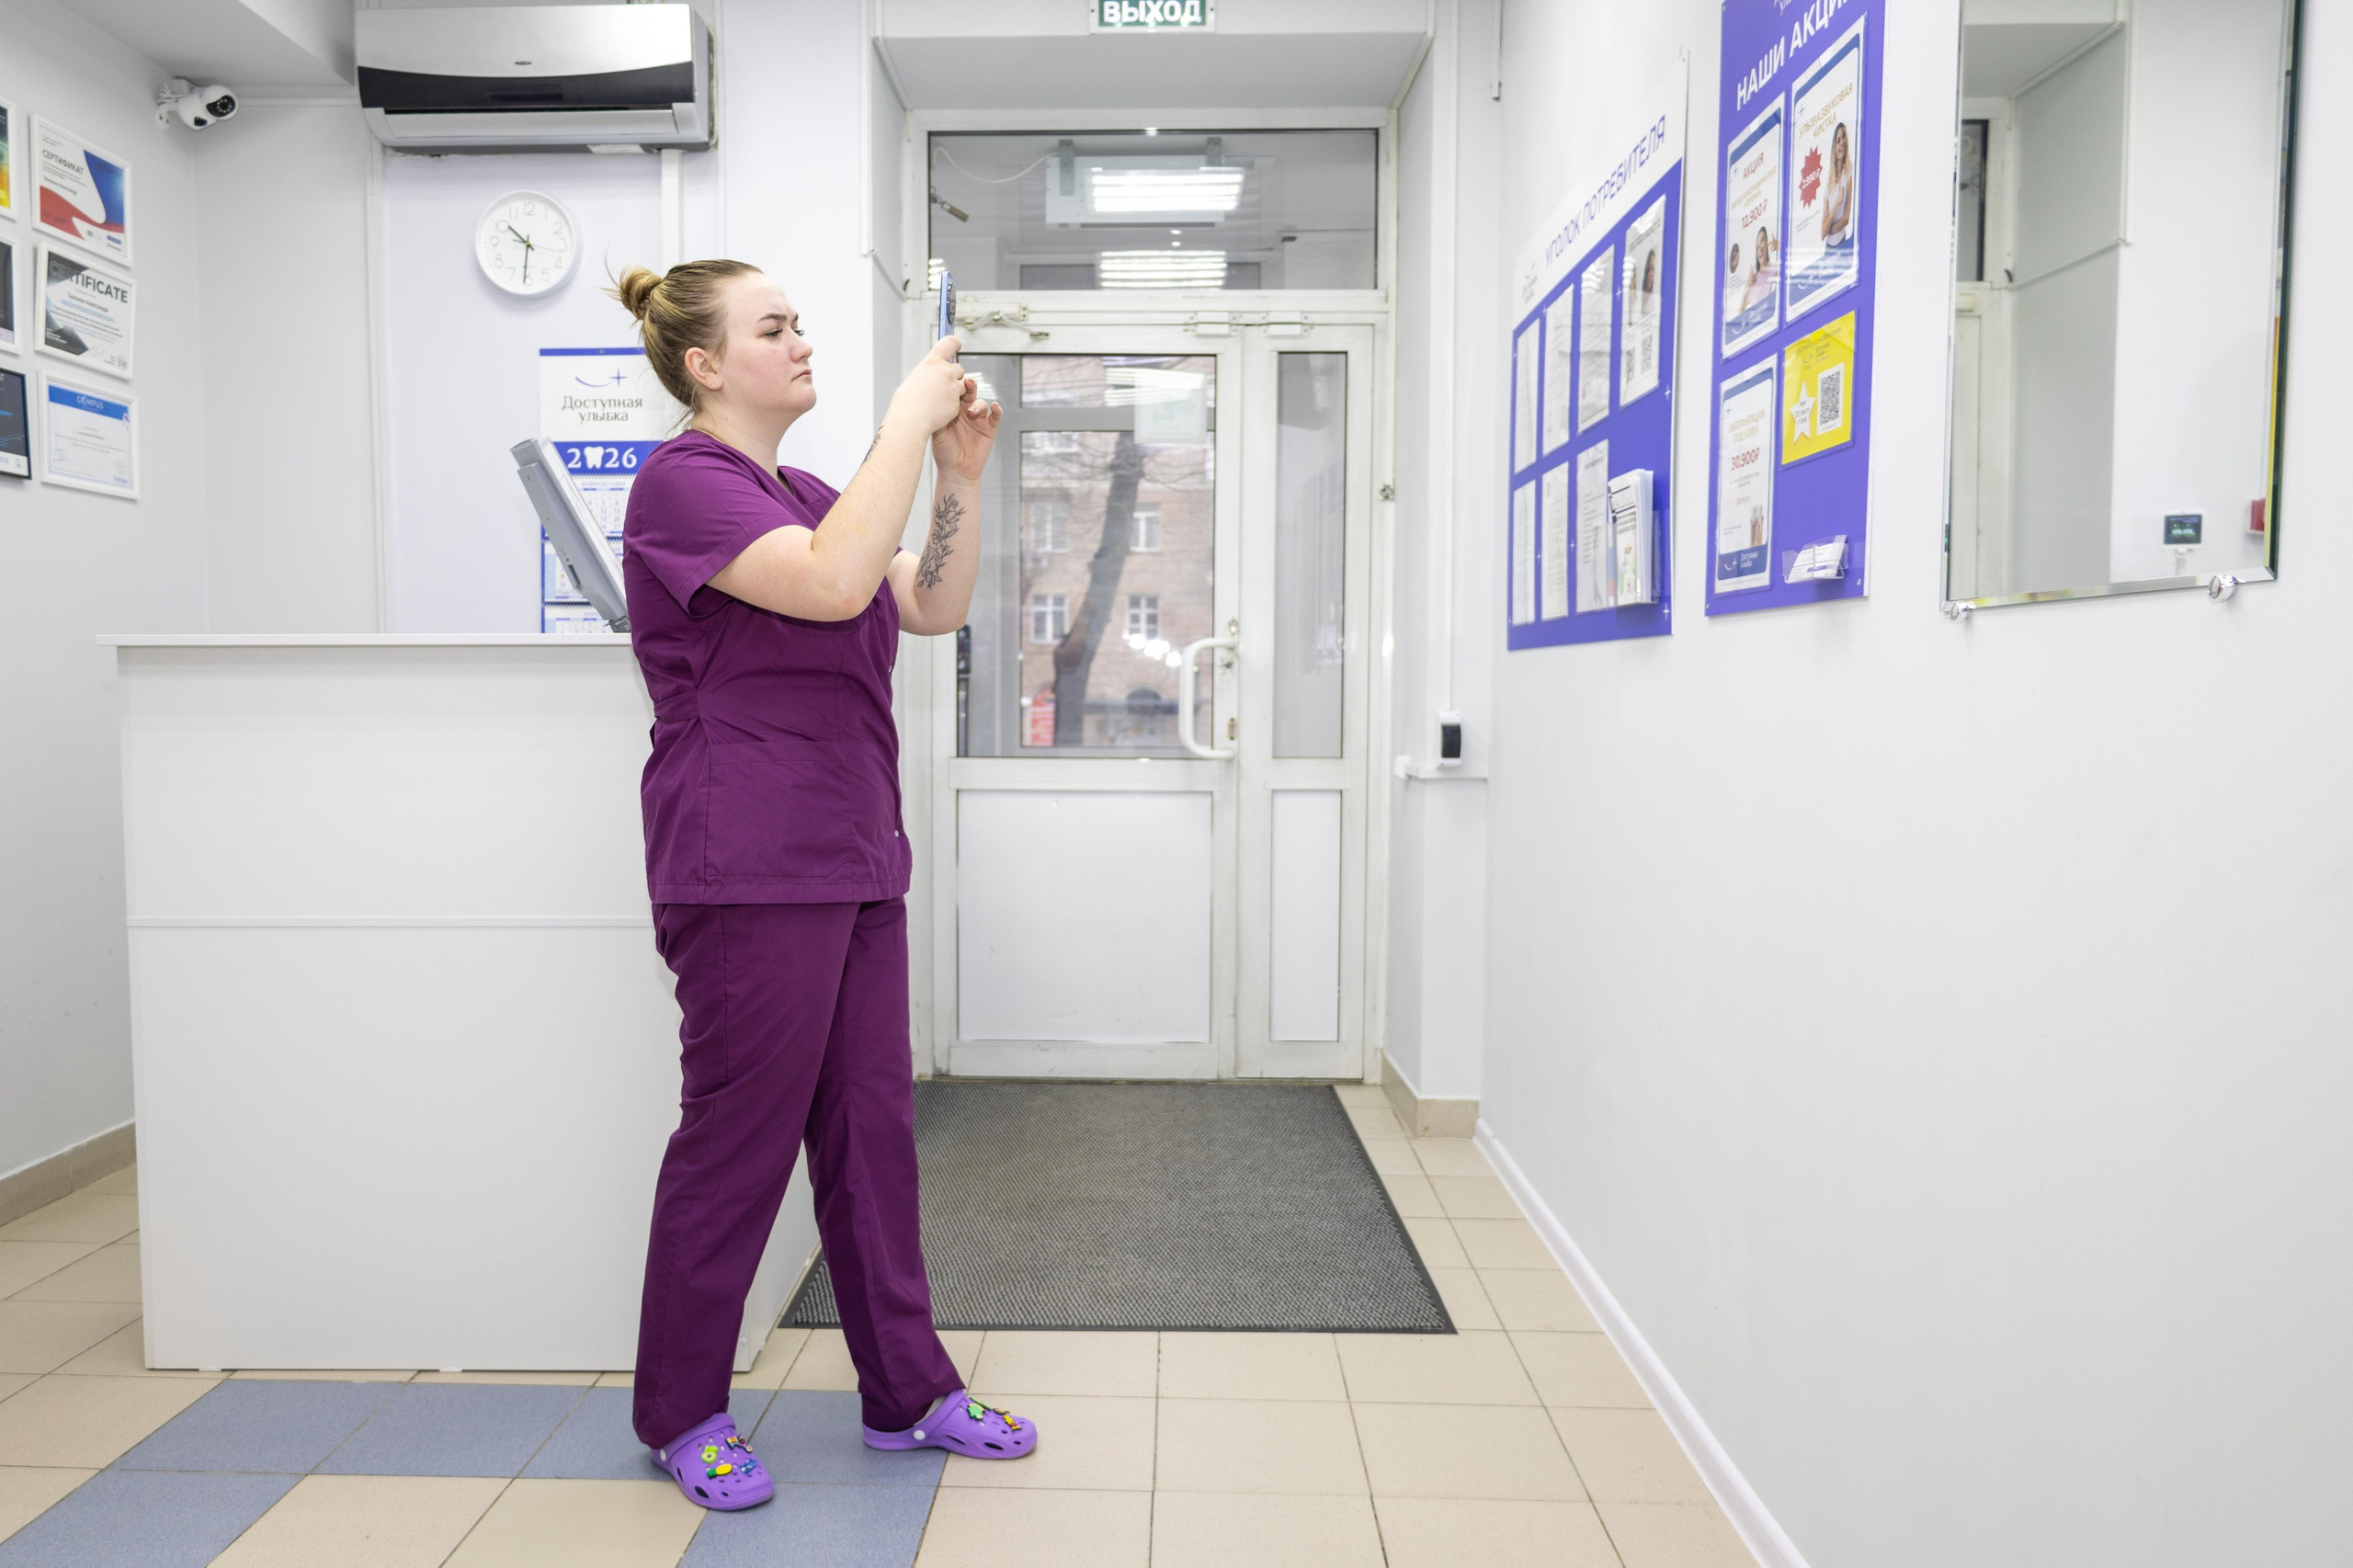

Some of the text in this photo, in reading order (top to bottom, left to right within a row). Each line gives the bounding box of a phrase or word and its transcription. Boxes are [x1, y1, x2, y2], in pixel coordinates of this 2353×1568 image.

[1103, 1, 1201, 24] ВЫХОД
[1737, 37, 1785, 111] НАШИ
[1799, 83, 1853, 139] УЛЬТРАЗВУКОВАЯ
[1813, 112, 1837, 138] ЧИСТКА
[42, 149, 85, 176] СЕРТИФИКАТ
[1743, 152, 1764, 180] АКЦИЯ
[1545, 210, 1583, 269] УГОЛОК
[1583, 114, 1665, 228] ПОТРЕБИТЕЛЯ
[508, 207, 518, 220] 11
[524, 201, 536, 216] 12
[494, 220, 509, 233] 10
[553, 221, 563, 234] 2
[490, 236, 500, 249] 9
[559, 237, 568, 252] 3
[494, 255, 504, 268] 8
[554, 256, 563, 268] 4
[506, 267, 517, 280] 7
[524, 272, 533, 286] 6
[541, 268, 551, 282] 5
[49, 260, 129, 303] CERTIFICATE
[563, 395, 643, 411] Доступная
[579, 410, 629, 425] улыбка
